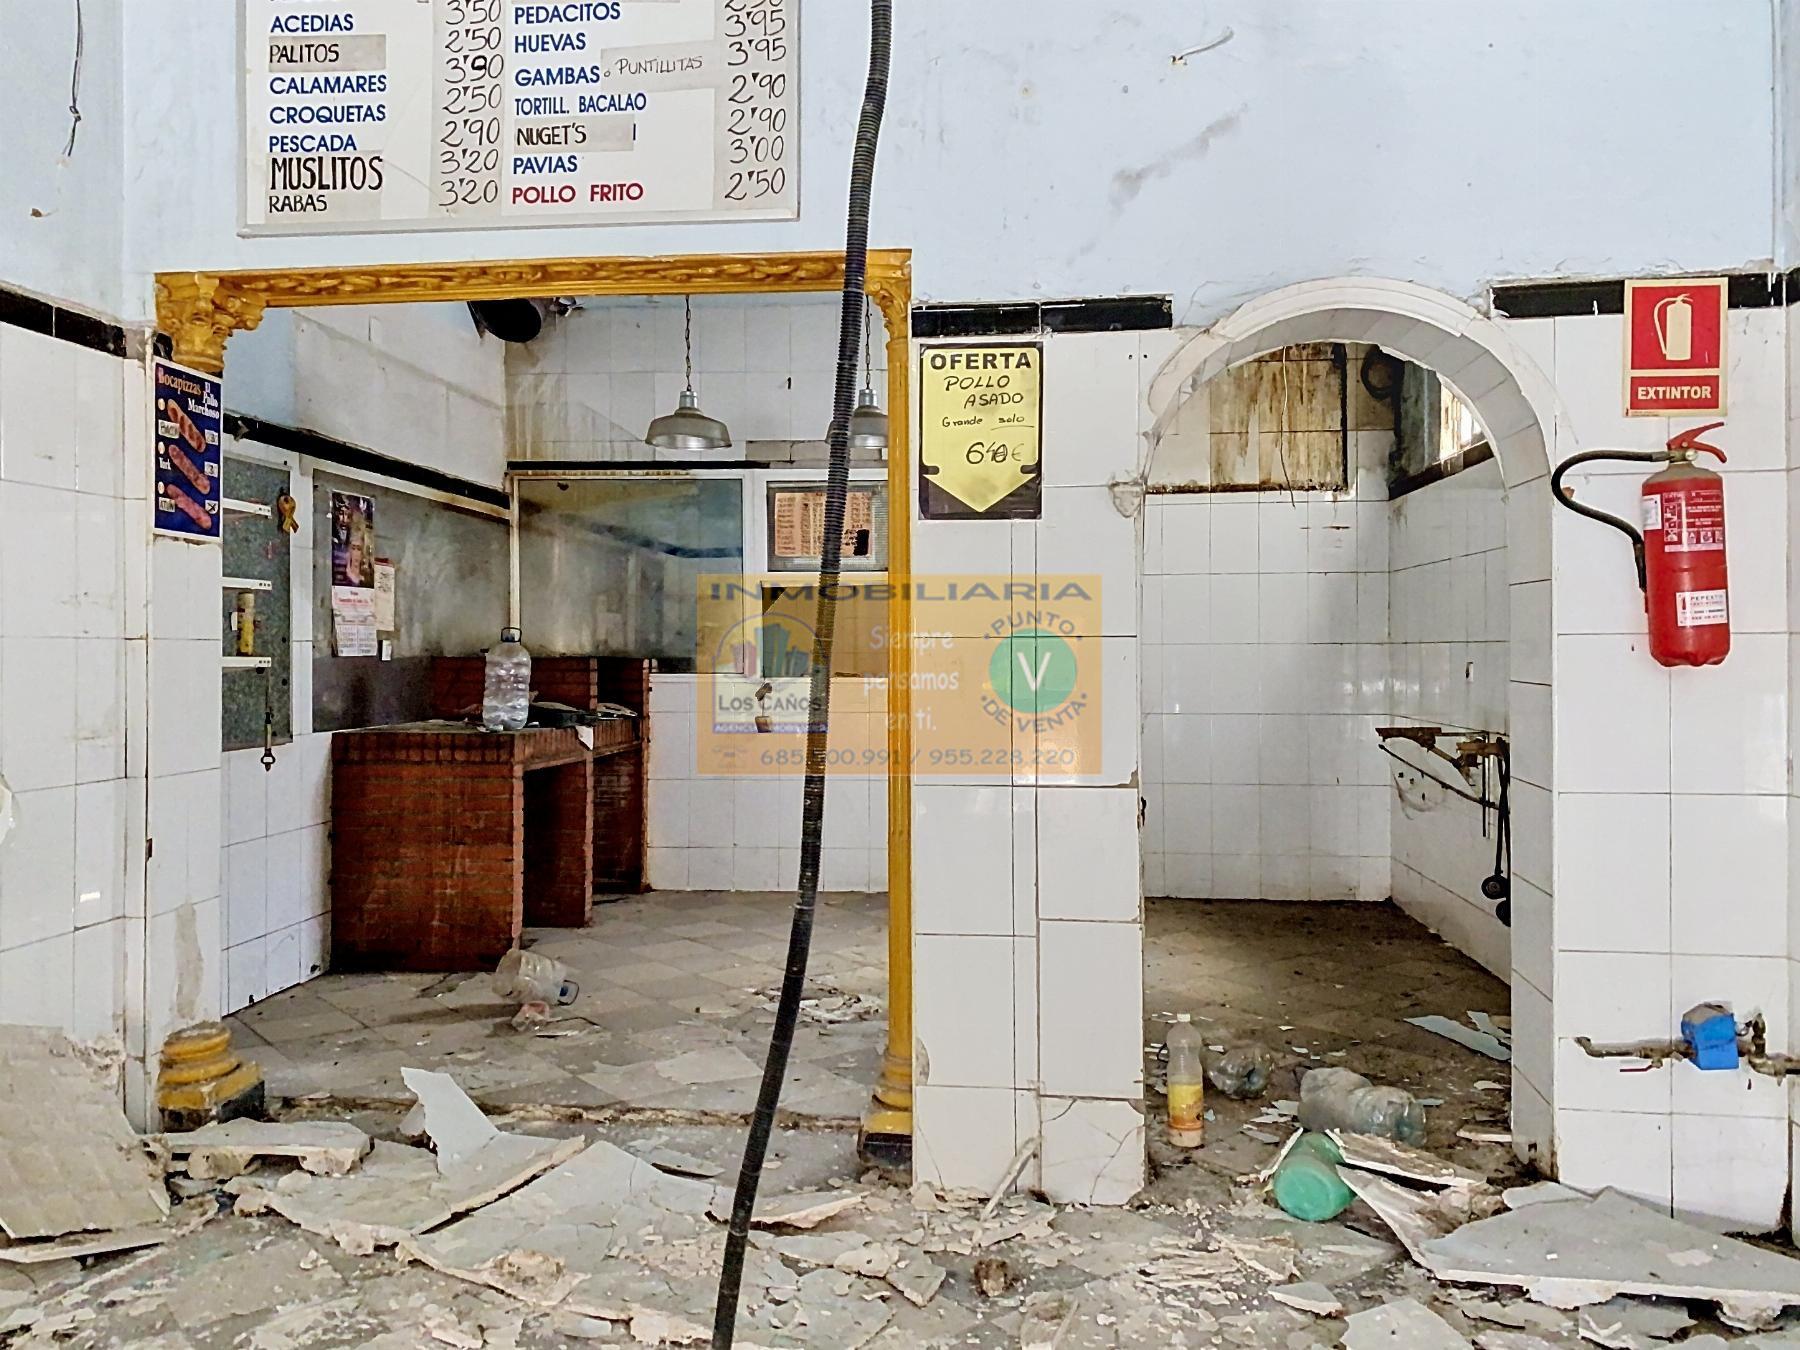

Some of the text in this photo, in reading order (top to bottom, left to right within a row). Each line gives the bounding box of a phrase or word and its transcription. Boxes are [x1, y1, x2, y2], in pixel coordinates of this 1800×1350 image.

[270, 14, 354, 33] ACEDIAS
[446, 0, 502, 25] 3'50
[515, 2, 621, 25] PEDACITOS
[725, 9, 786, 37] 3'95
[445, 27, 502, 53] 2'50
[514, 32, 586, 53] HUEVAS
[269, 43, 340, 64] PALITOS
[728, 39, 787, 67] 3'95
[269, 75, 387, 95] CALAMARES
[515, 66, 600, 87] GAMBAS
[728, 72, 786, 104] 2'90
[442, 83, 502, 115] 2'50
[515, 92, 647, 116] TORTILL. BACALAO
[269, 104, 387, 124] CROQUETAS
[727, 107, 786, 135] 2'90
[269, 134, 357, 153] PESCADA
[440, 117, 501, 147] 2'90
[516, 122, 587, 146] NUGET'S
[440, 148, 499, 174] 3'20
[729, 135, 785, 164] 3'00
[270, 155, 383, 191] MUSLITOS
[512, 154, 578, 175] PAVIAS
[438, 178, 499, 207] 3'20
[512, 182, 644, 204] POLLO FRITO
[725, 167, 786, 201] 2'50
[268, 194, 328, 214] RABAS
[930, 352, 1032, 370] OFERTA
[944, 375, 1010, 392] POLLO
[1637, 385, 1712, 400] EXTINTOR
[963, 392, 1024, 409] ASADO
[942, 413, 1025, 428] Grande solo
